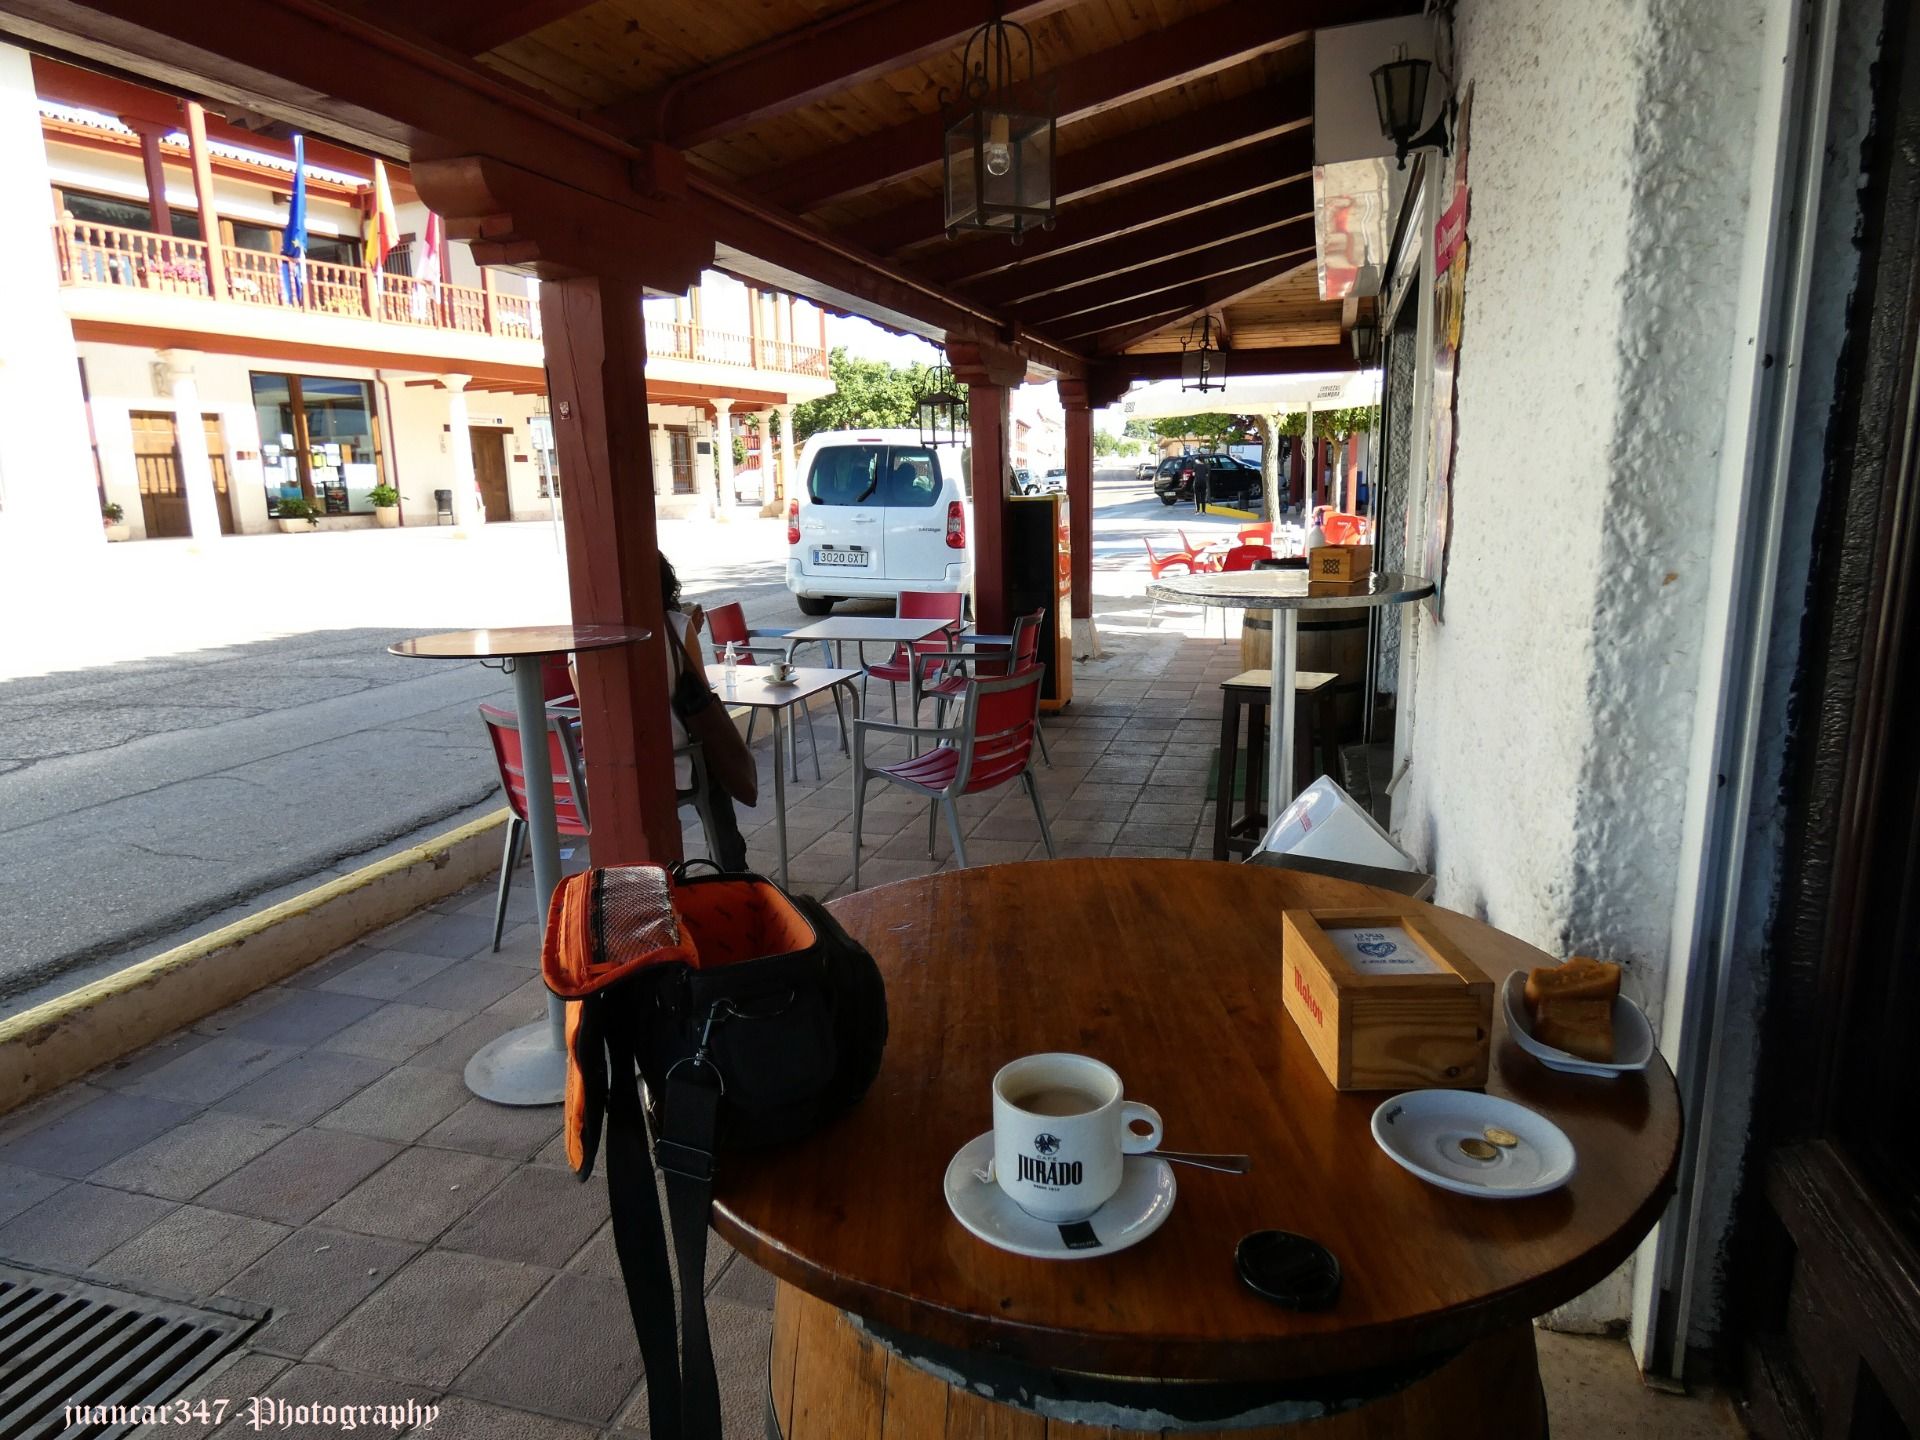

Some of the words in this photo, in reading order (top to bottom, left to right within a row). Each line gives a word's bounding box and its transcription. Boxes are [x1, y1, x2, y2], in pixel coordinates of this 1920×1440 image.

[820, 552, 845, 563] 3020
[847, 553, 865, 563] GXT
[1294, 965, 1324, 1028] Mahou
[1037, 1154, 1058, 1162] CAFÉ
[1016, 1153, 1083, 1186] JURADO
